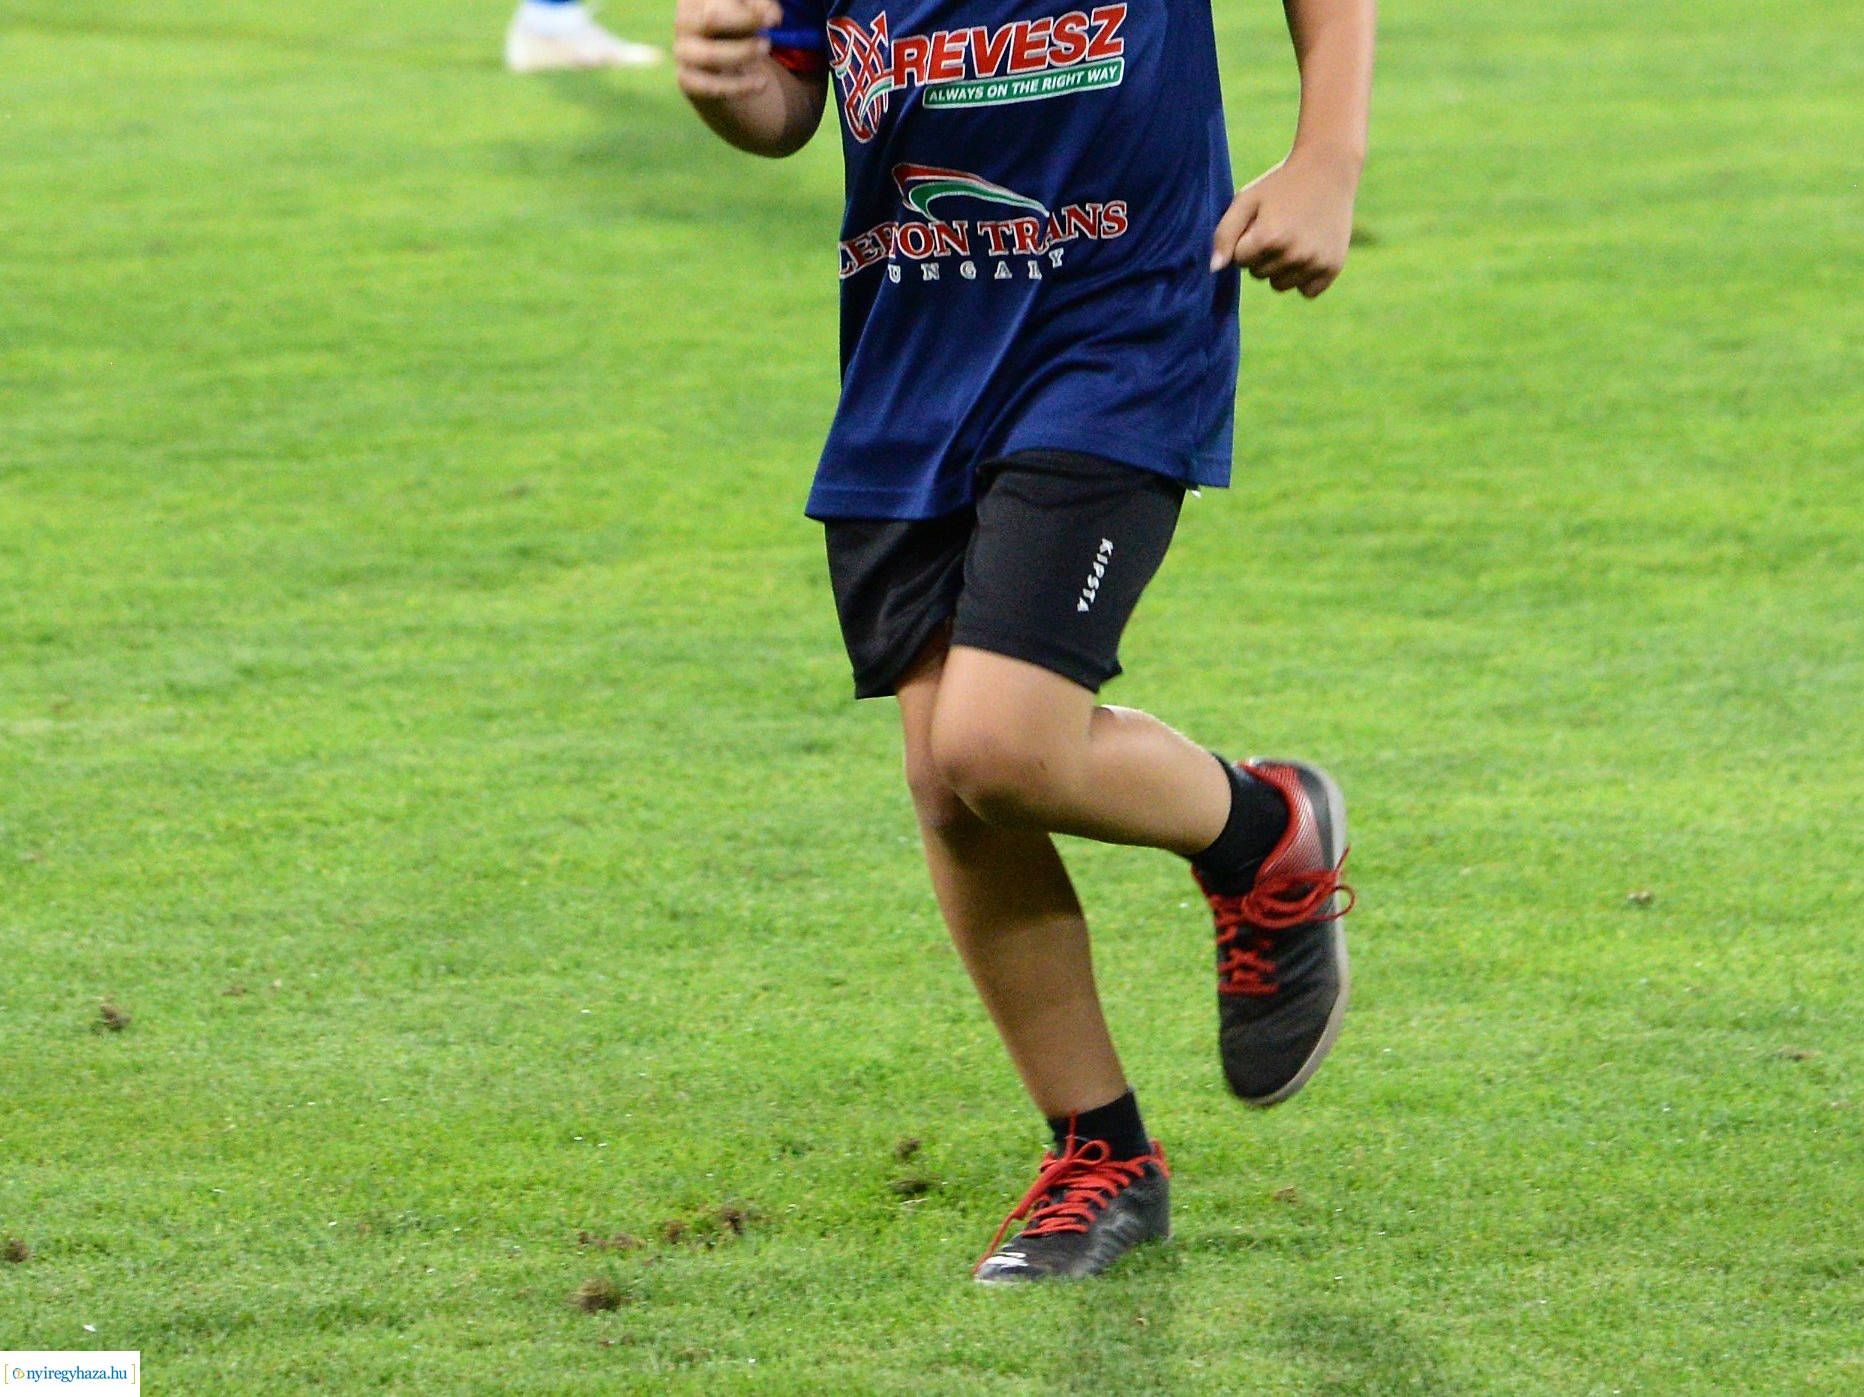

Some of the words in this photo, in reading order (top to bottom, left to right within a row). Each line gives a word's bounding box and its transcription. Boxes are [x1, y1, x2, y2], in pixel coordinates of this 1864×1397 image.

[929, 85, 984, 102] ALWAYS
[987, 82, 1008, 99] ON
[1011, 79, 1040, 95] THE
[1042, 70, 1085, 91] RIGHT
[1087, 65, 1118, 83] WAY
[977, 199, 1129, 256] TRANS
[1077, 537, 1114, 612] KIPSTA
